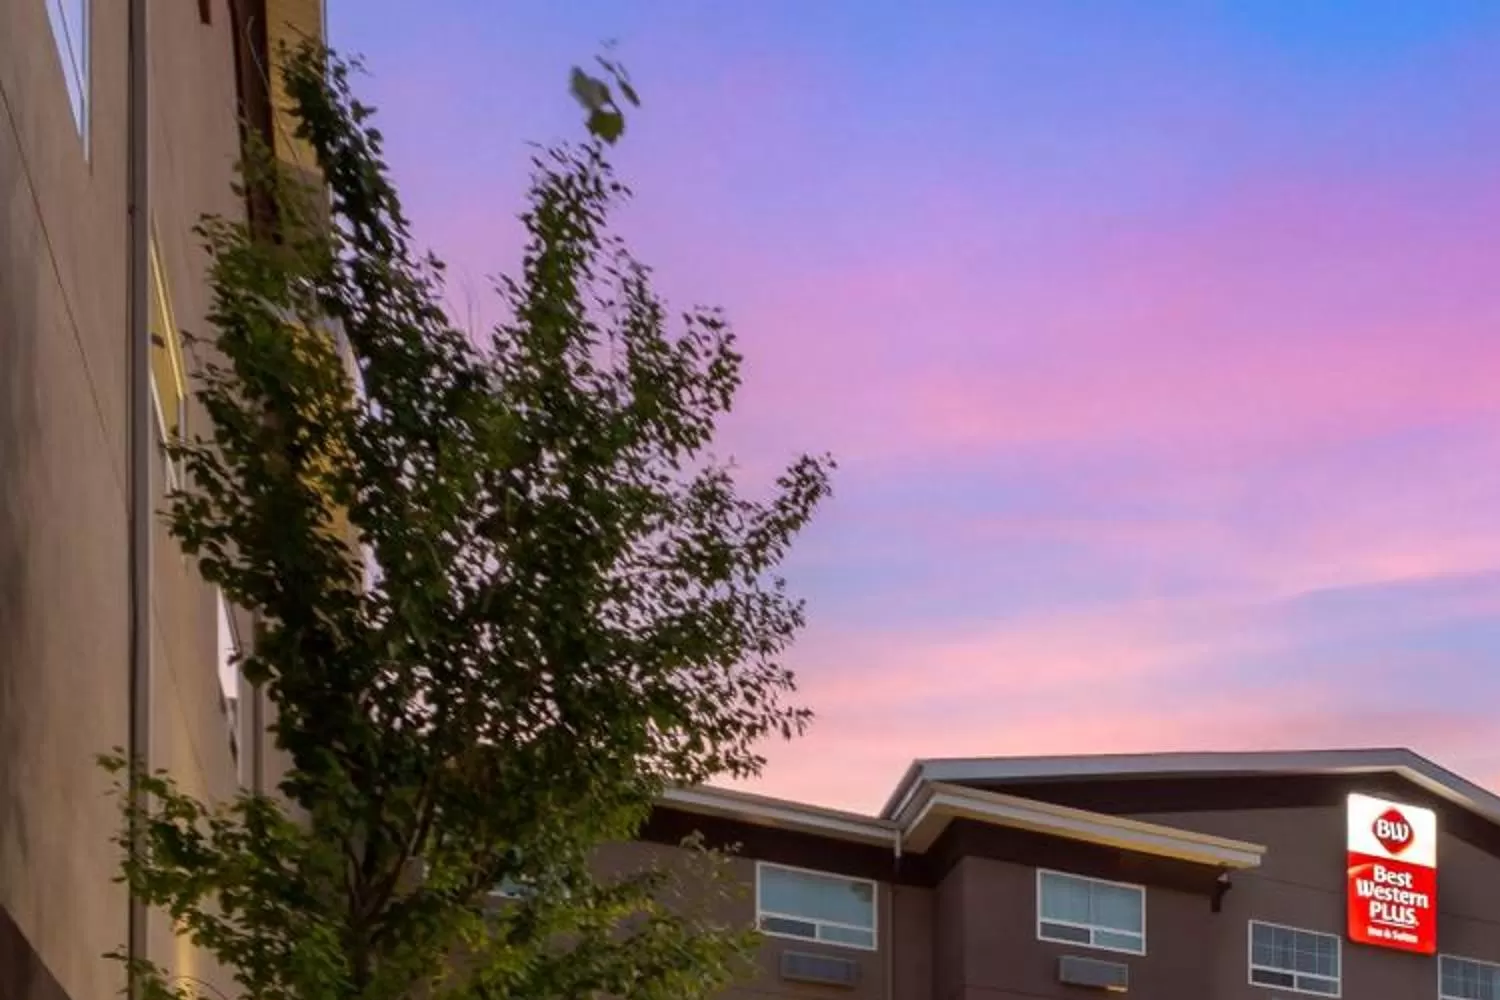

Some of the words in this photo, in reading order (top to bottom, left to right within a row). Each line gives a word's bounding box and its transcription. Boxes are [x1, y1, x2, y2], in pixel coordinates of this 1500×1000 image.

[1376, 819, 1409, 842] BW
[1373, 864, 1413, 888] Best
[1356, 878, 1429, 909] Western
[1369, 901, 1417, 925] PLUS
